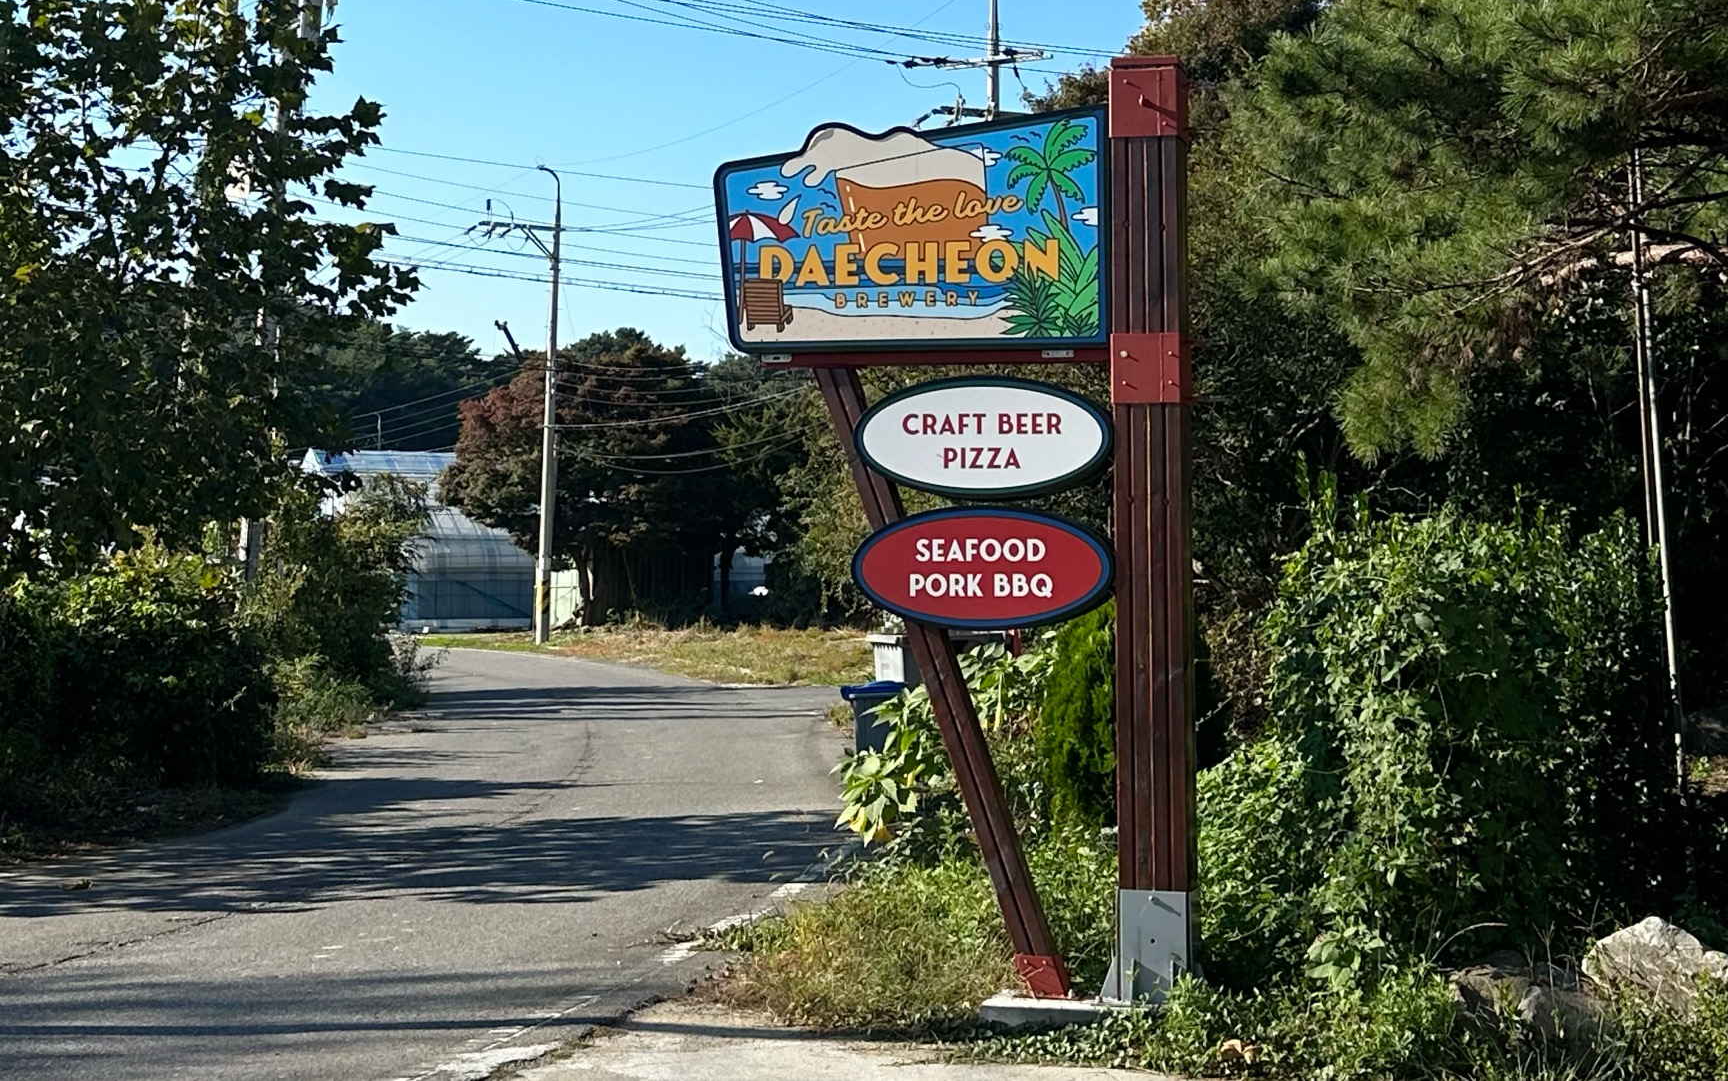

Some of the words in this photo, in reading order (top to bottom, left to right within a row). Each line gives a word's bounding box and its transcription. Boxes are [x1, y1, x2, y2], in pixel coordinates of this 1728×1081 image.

[801, 206, 888, 238] Taste
[893, 196, 949, 226] the
[955, 190, 1024, 218] love
[759, 239, 1060, 286] DAECHEON
[834, 290, 980, 308] BREWERY
[902, 413, 987, 436] CRAFT
[998, 413, 1063, 435] BEER
[943, 447, 1022, 469] PIZZA
[915, 538, 1047, 563] SEAFOOD
[909, 573, 984, 598] PORK
[993, 573, 1054, 599] BBQ
